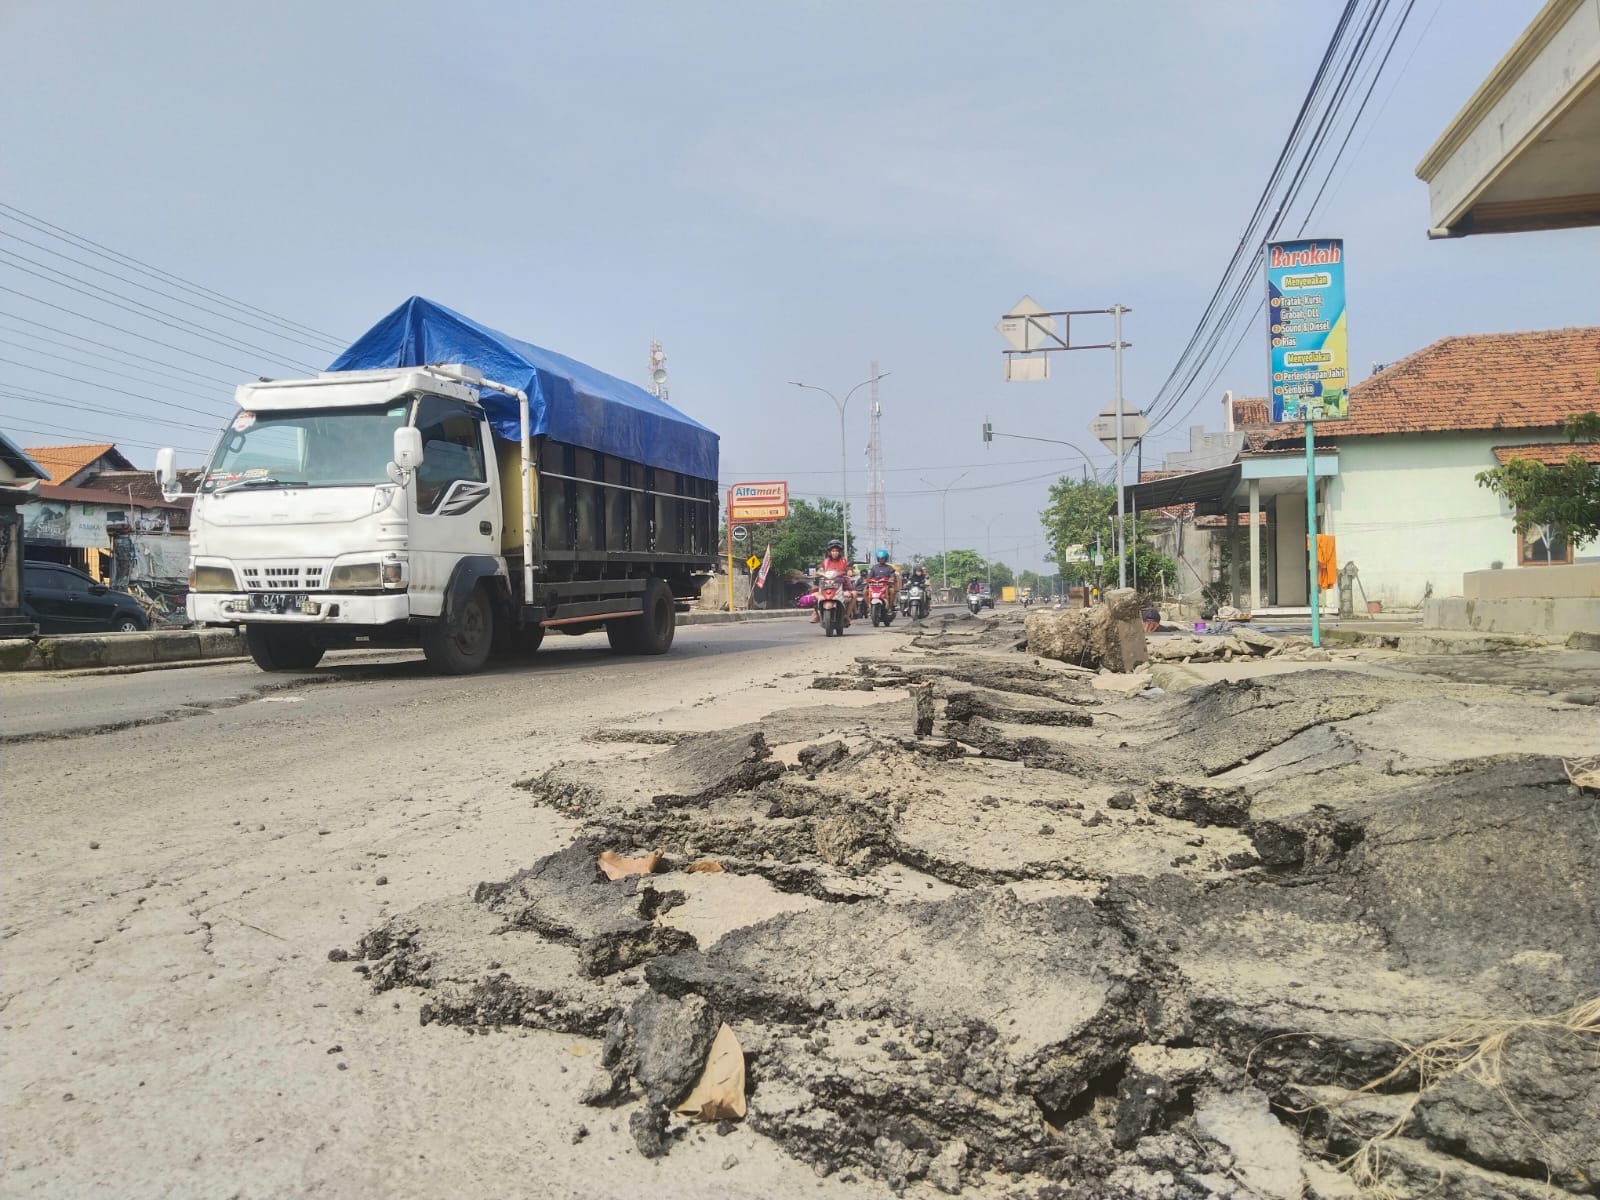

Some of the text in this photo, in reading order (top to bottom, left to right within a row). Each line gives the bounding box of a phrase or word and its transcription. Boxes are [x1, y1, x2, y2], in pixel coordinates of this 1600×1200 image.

[1271, 241, 1341, 268] Barokah
[1284, 275, 1329, 288] Menyewakan
[1281, 323, 1302, 333] Sound
[1309, 320, 1329, 331] Diesel
[1282, 337, 1297, 347] Rias
[1287, 352, 1331, 365] Menyediakan
[1329, 368, 1345, 379] Jahit
[1284, 384, 1314, 394] Sembako
[735, 487, 781, 496] Alfamart
